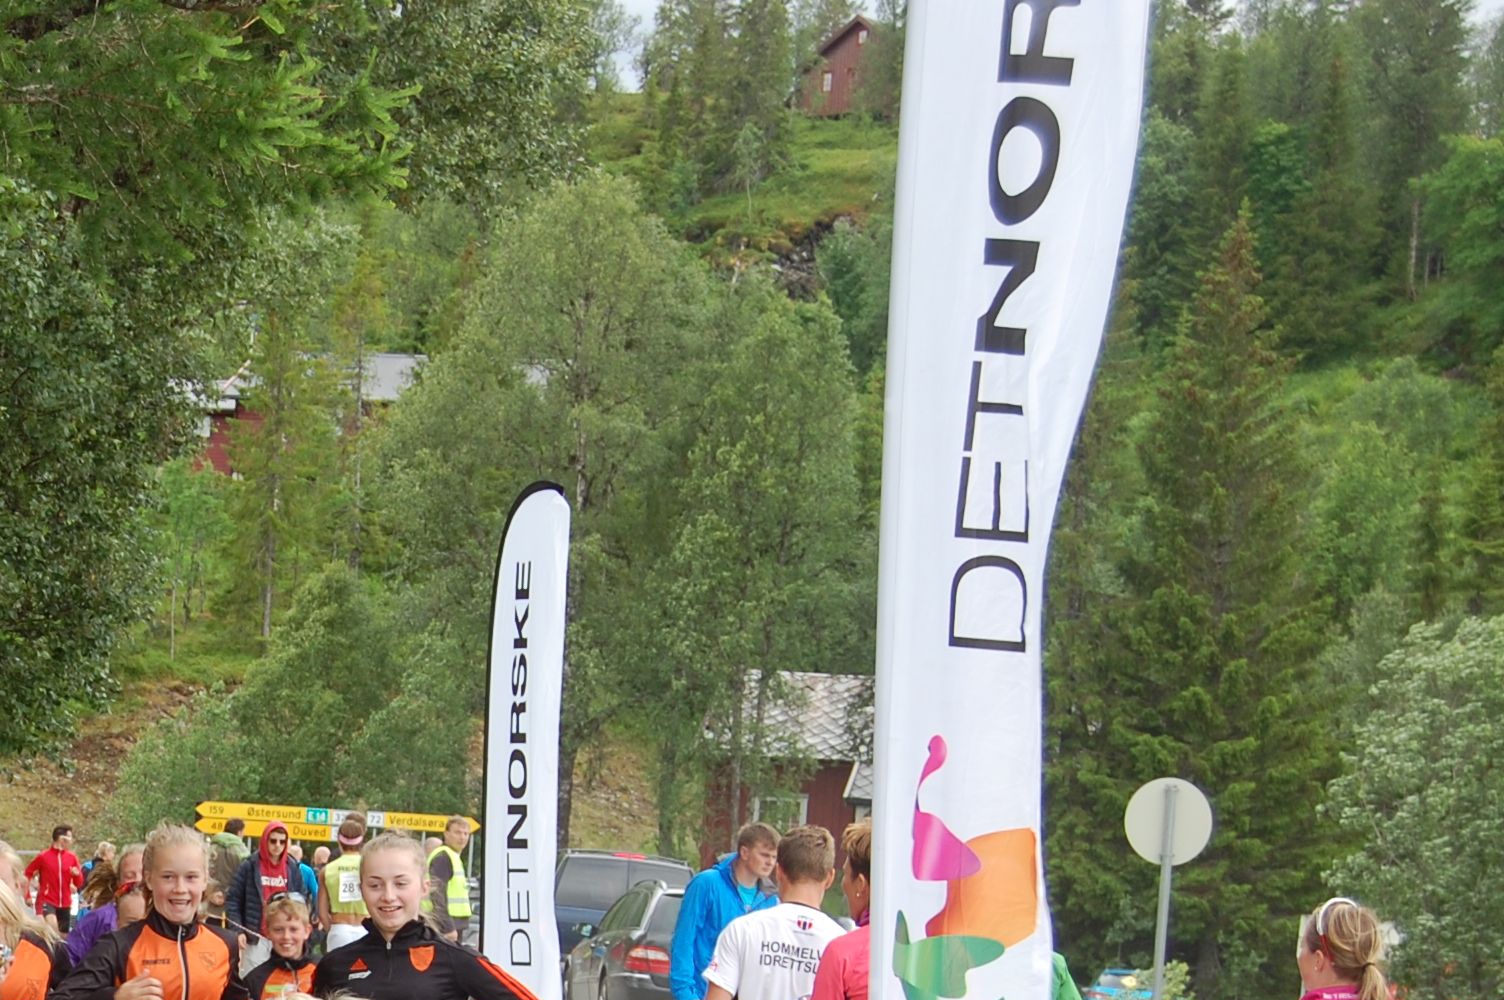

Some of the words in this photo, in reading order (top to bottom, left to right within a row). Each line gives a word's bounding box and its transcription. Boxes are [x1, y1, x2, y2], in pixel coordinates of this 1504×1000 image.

[209, 805, 224, 815] 159
[247, 807, 301, 819] Østersund
[370, 815, 382, 824] 72
[389, 815, 445, 828] Verdalsøra
[211, 822, 223, 831] 48
[293, 825, 326, 837] Duved
